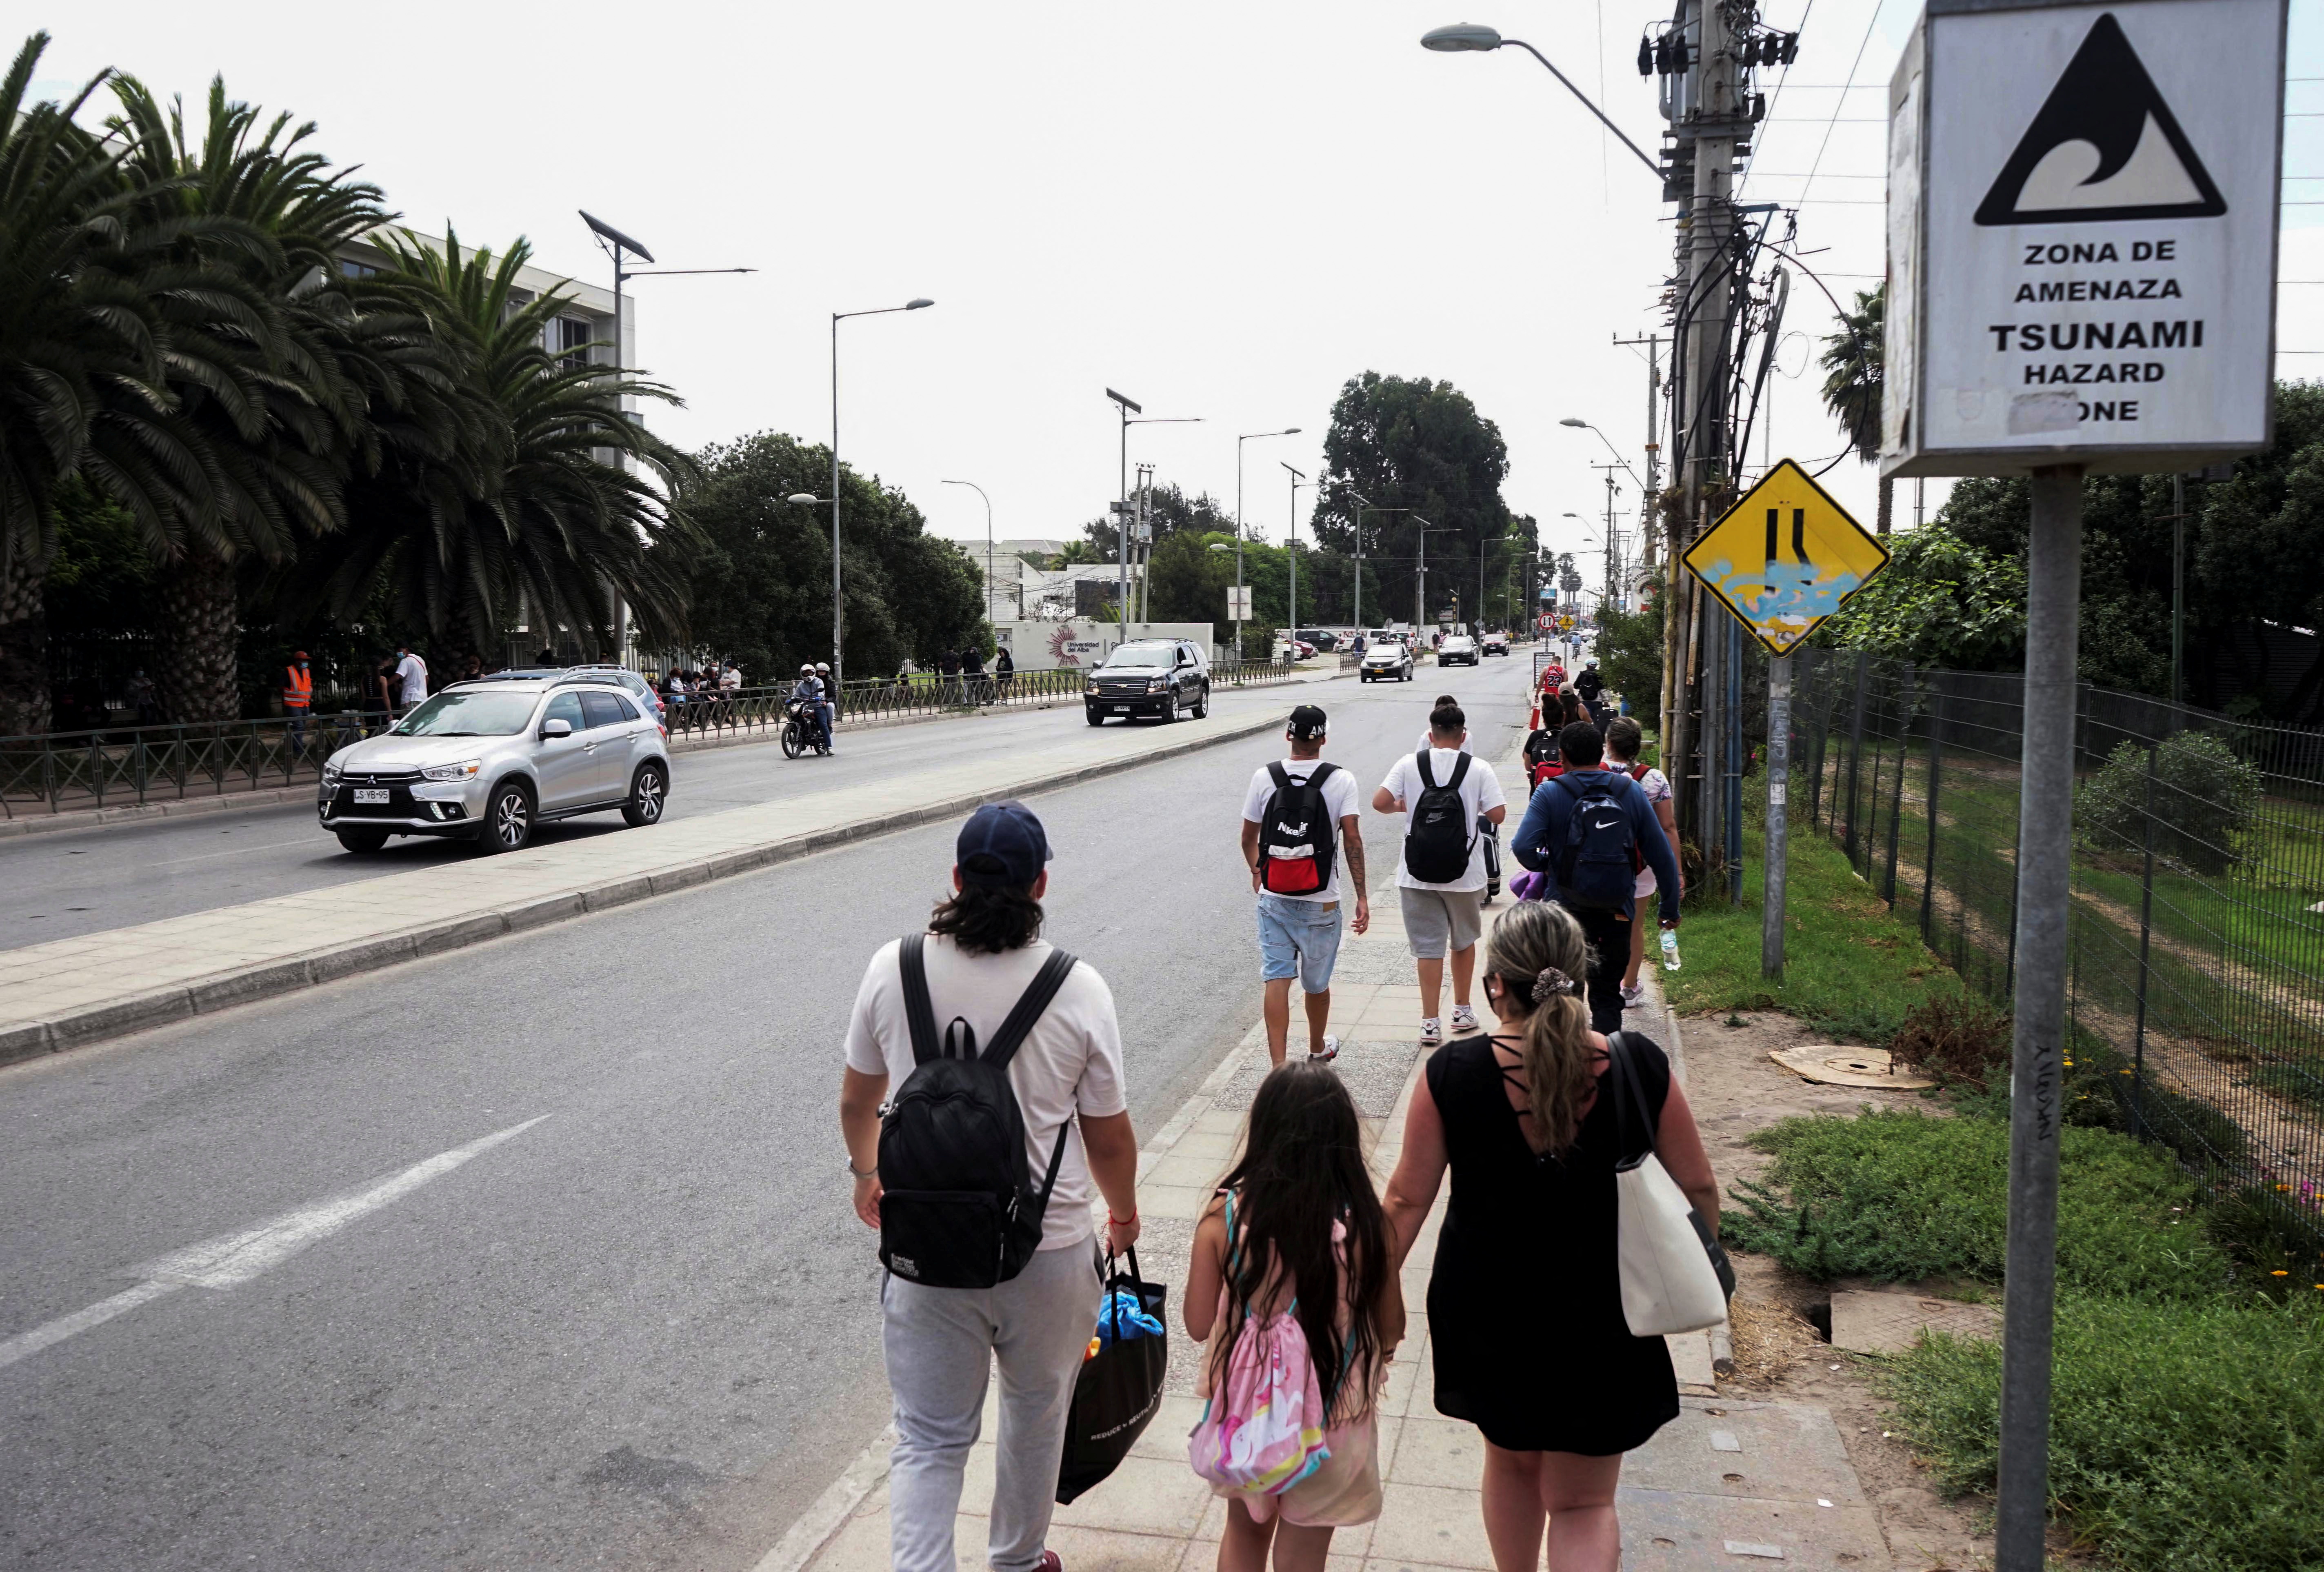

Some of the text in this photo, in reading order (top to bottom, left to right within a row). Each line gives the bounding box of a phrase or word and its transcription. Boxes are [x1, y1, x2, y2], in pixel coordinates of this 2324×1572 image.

[2023, 240, 2176, 265] ZONA DE
[2013, 278, 2182, 303] AMENAZA
[1989, 320, 2204, 352] TSUNAMI
[2024, 362, 2166, 385] HAZARD
[2077, 400, 2139, 422] ONE
[1547, 674, 1562, 687] 23
[1091, 1425, 1122, 1440] REDUCE
